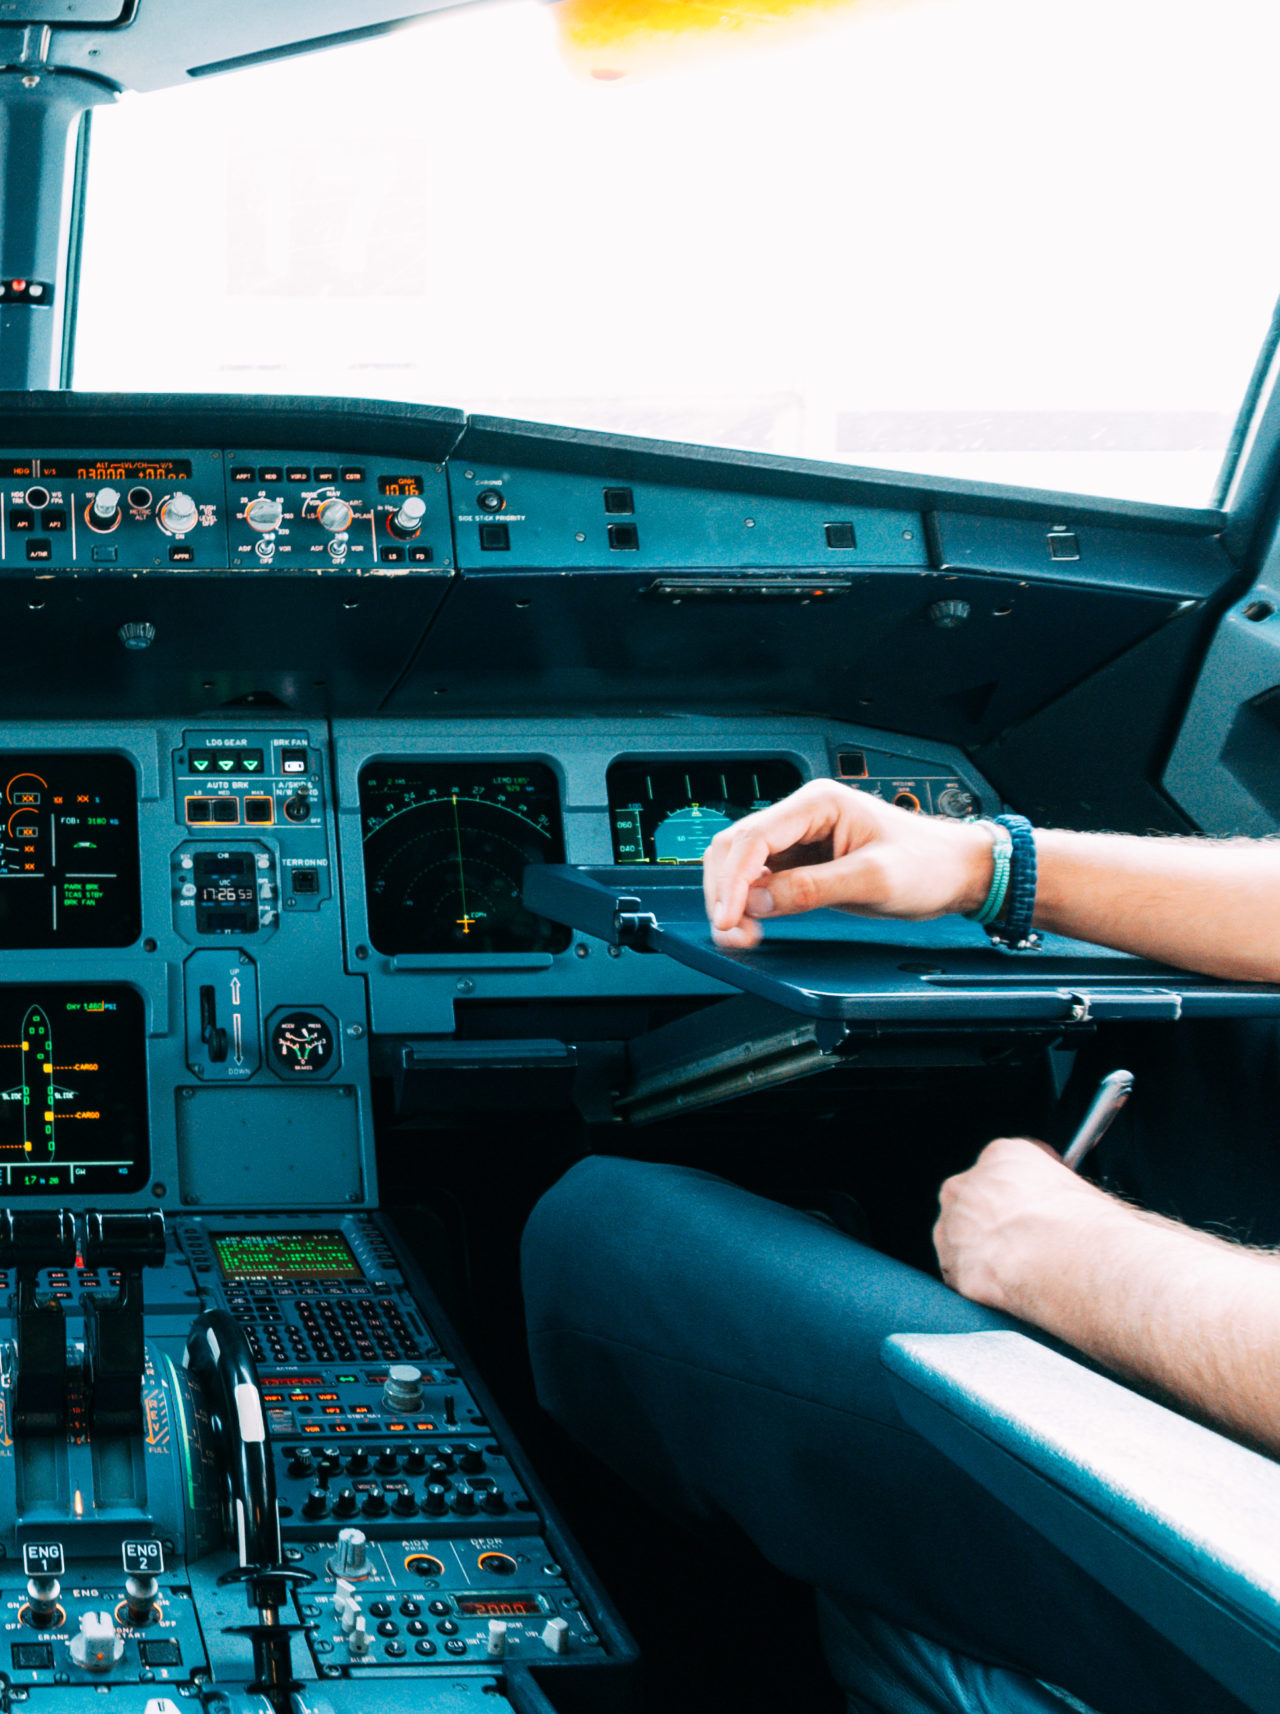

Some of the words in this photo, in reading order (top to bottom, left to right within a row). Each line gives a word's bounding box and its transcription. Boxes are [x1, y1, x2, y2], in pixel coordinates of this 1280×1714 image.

[28, 1546, 59, 1558] ENG
[127, 1544, 157, 1557] ENG
[41, 1560, 47, 1571] 1
[140, 1558, 148, 1569] 2
[73, 1590, 99, 1598] ENG
